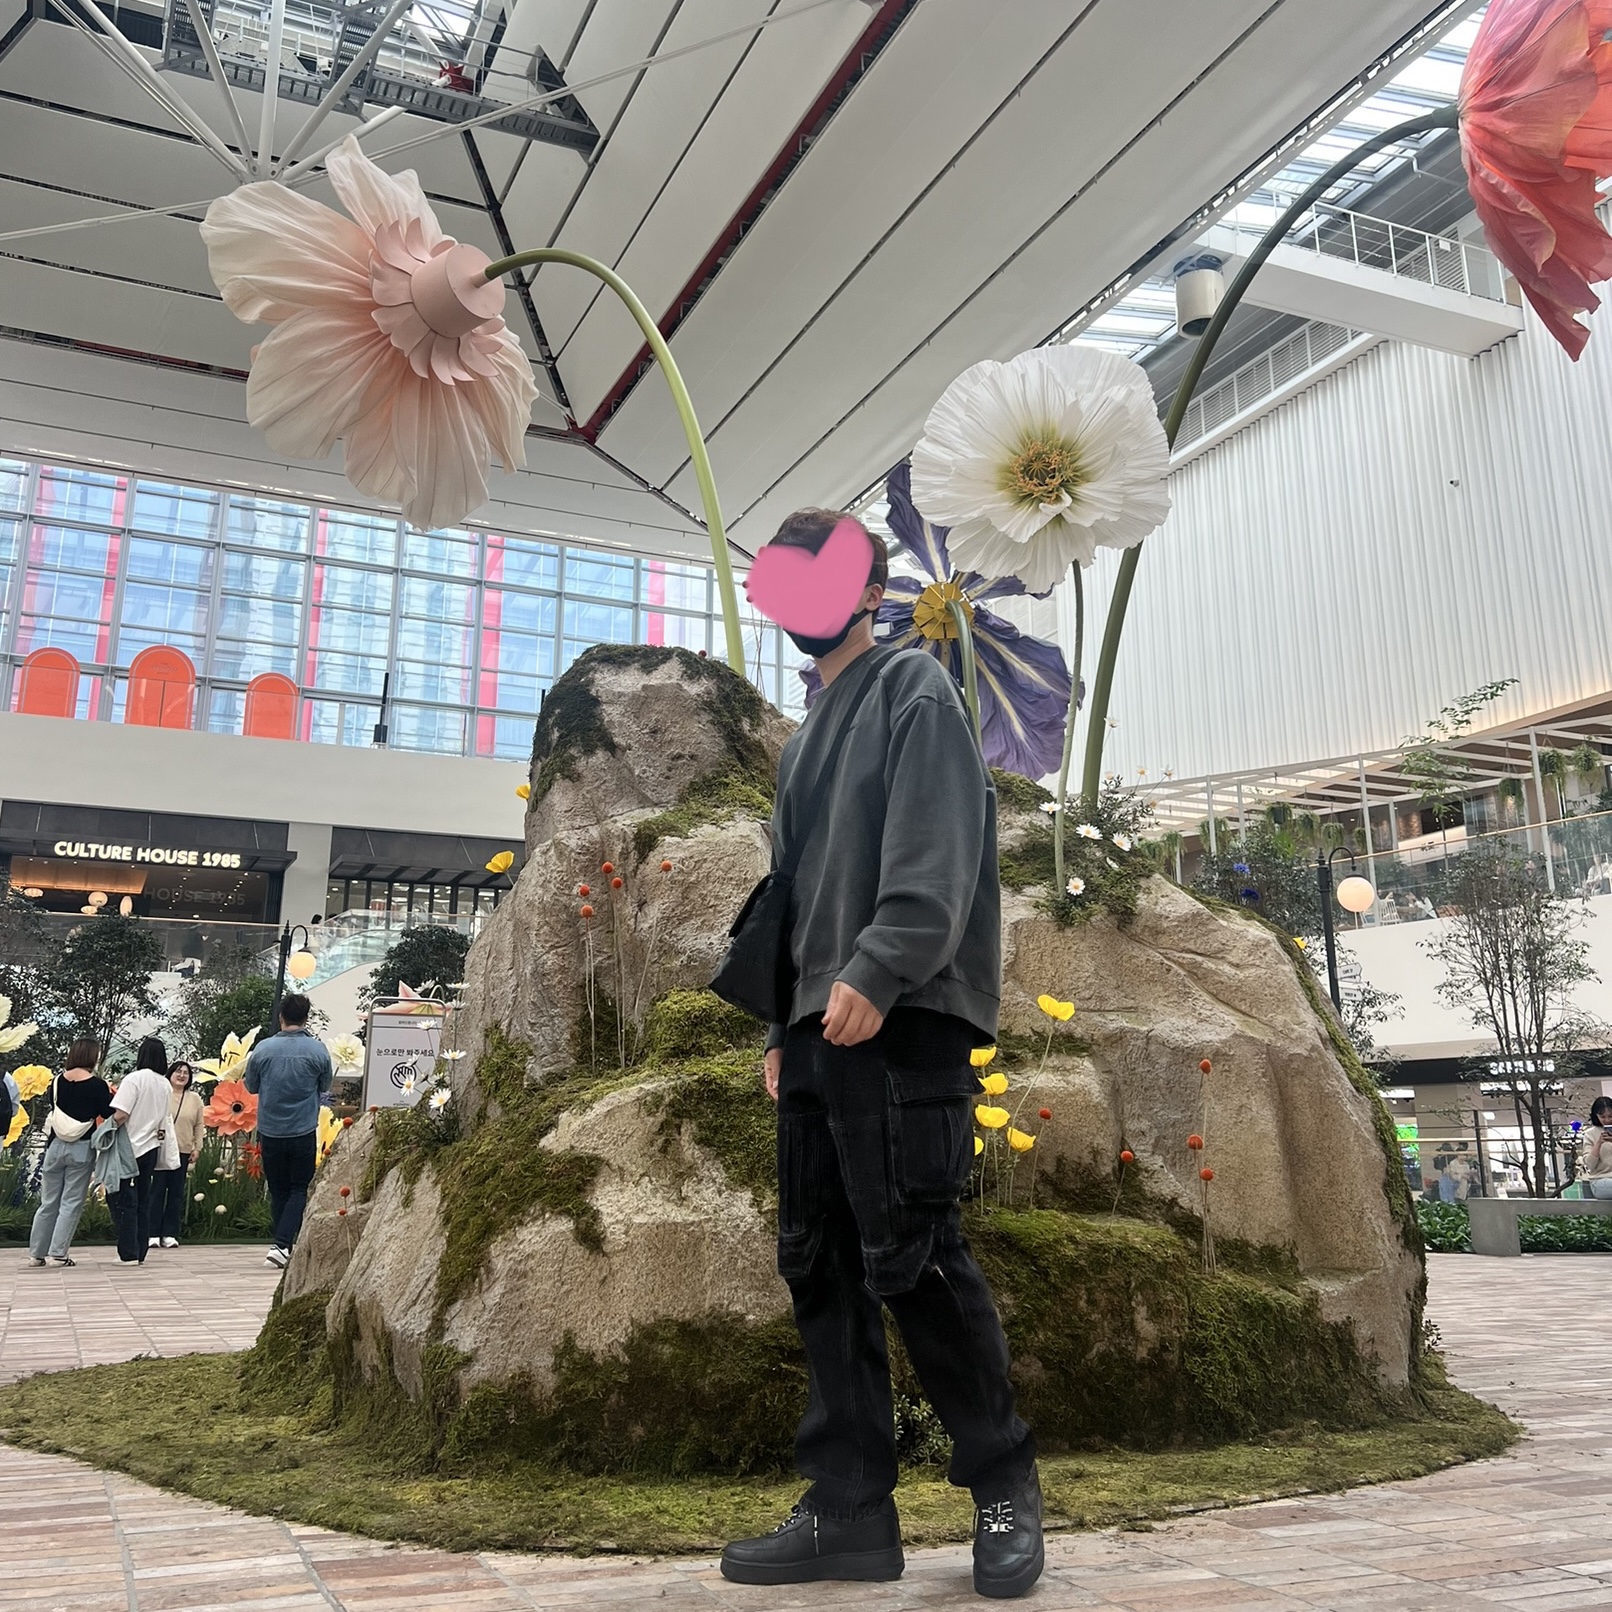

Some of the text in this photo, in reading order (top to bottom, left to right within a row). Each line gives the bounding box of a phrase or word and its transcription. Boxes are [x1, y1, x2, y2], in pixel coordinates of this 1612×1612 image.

[54, 841, 241, 868] CULTURE HOUSE 1985
[376, 1048, 405, 1057] 눈으로만
